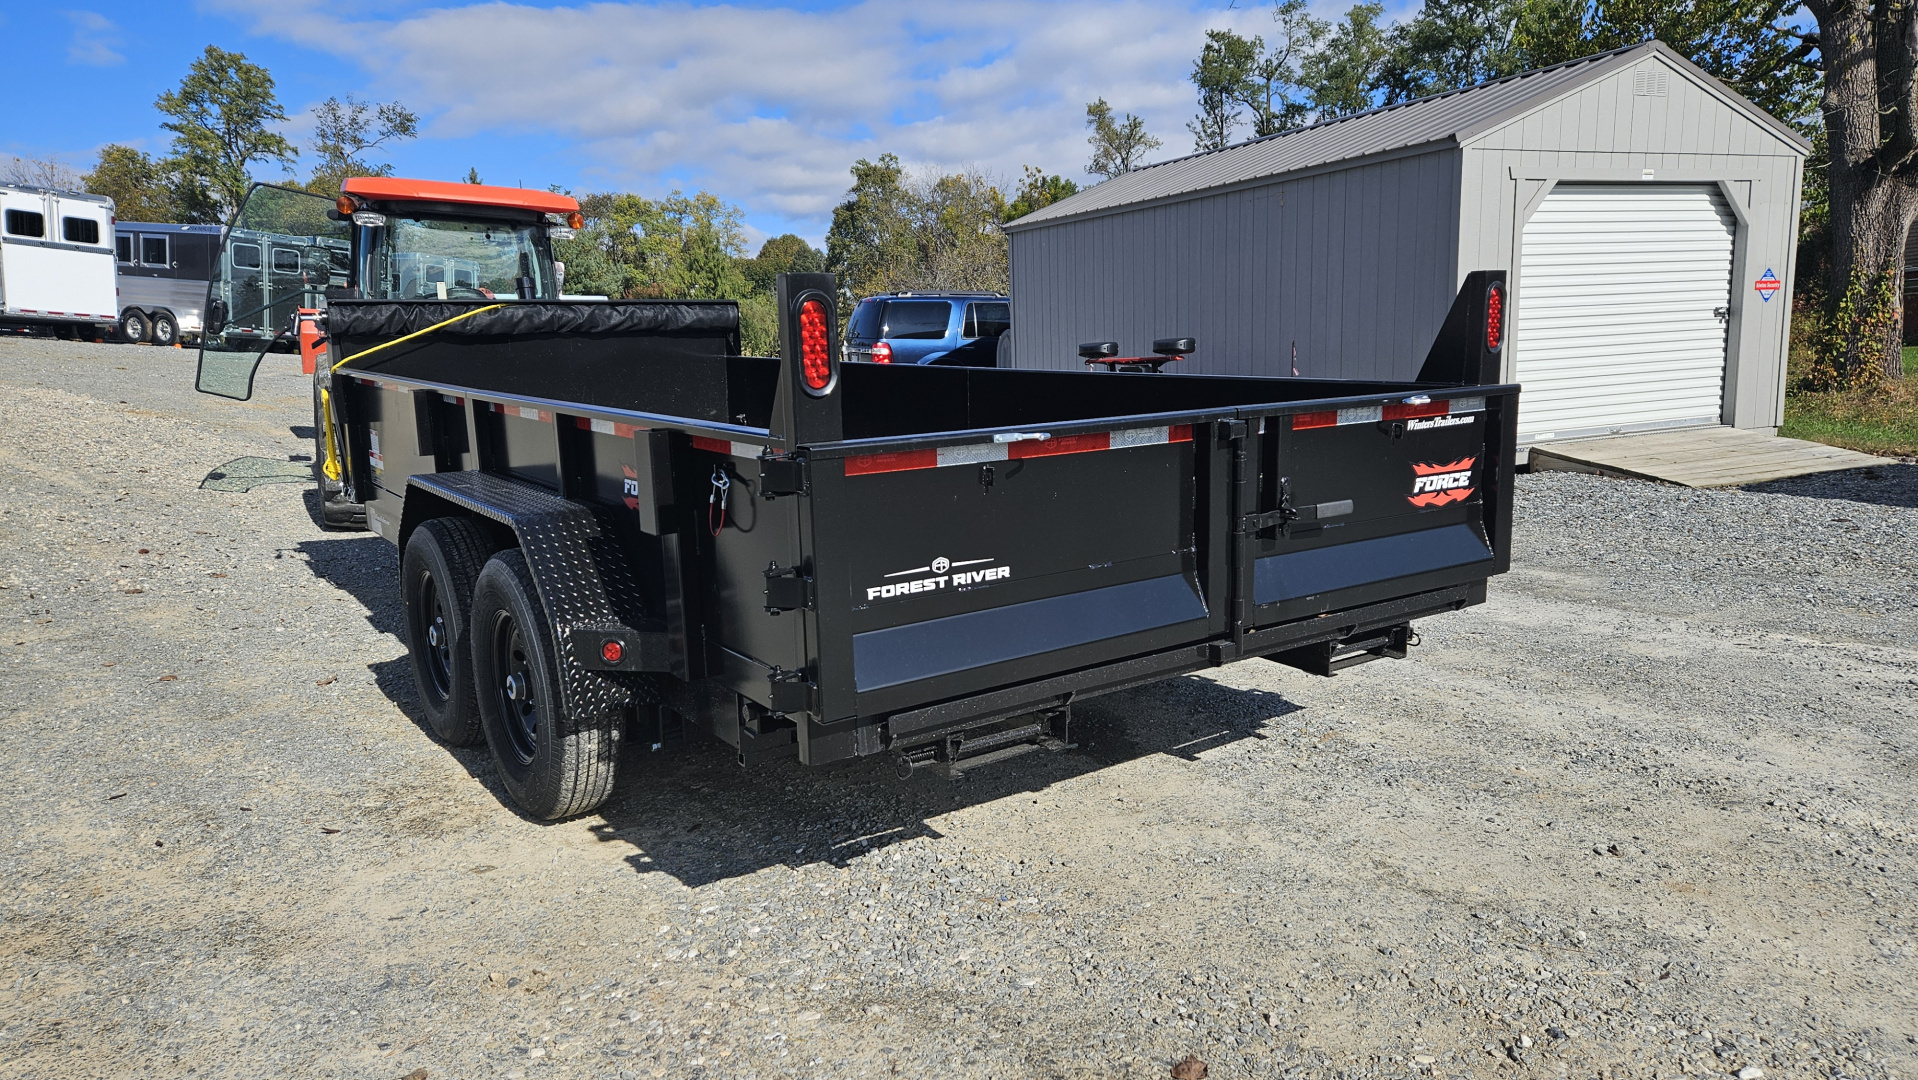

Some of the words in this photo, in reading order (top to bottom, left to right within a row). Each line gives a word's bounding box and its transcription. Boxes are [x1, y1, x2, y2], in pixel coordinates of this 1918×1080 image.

[1407, 415, 1475, 431] WintersTrailers.com
[1413, 470, 1472, 494] FORCE
[866, 575, 949, 600] FOREST
[952, 566, 1011, 587] RIVER
